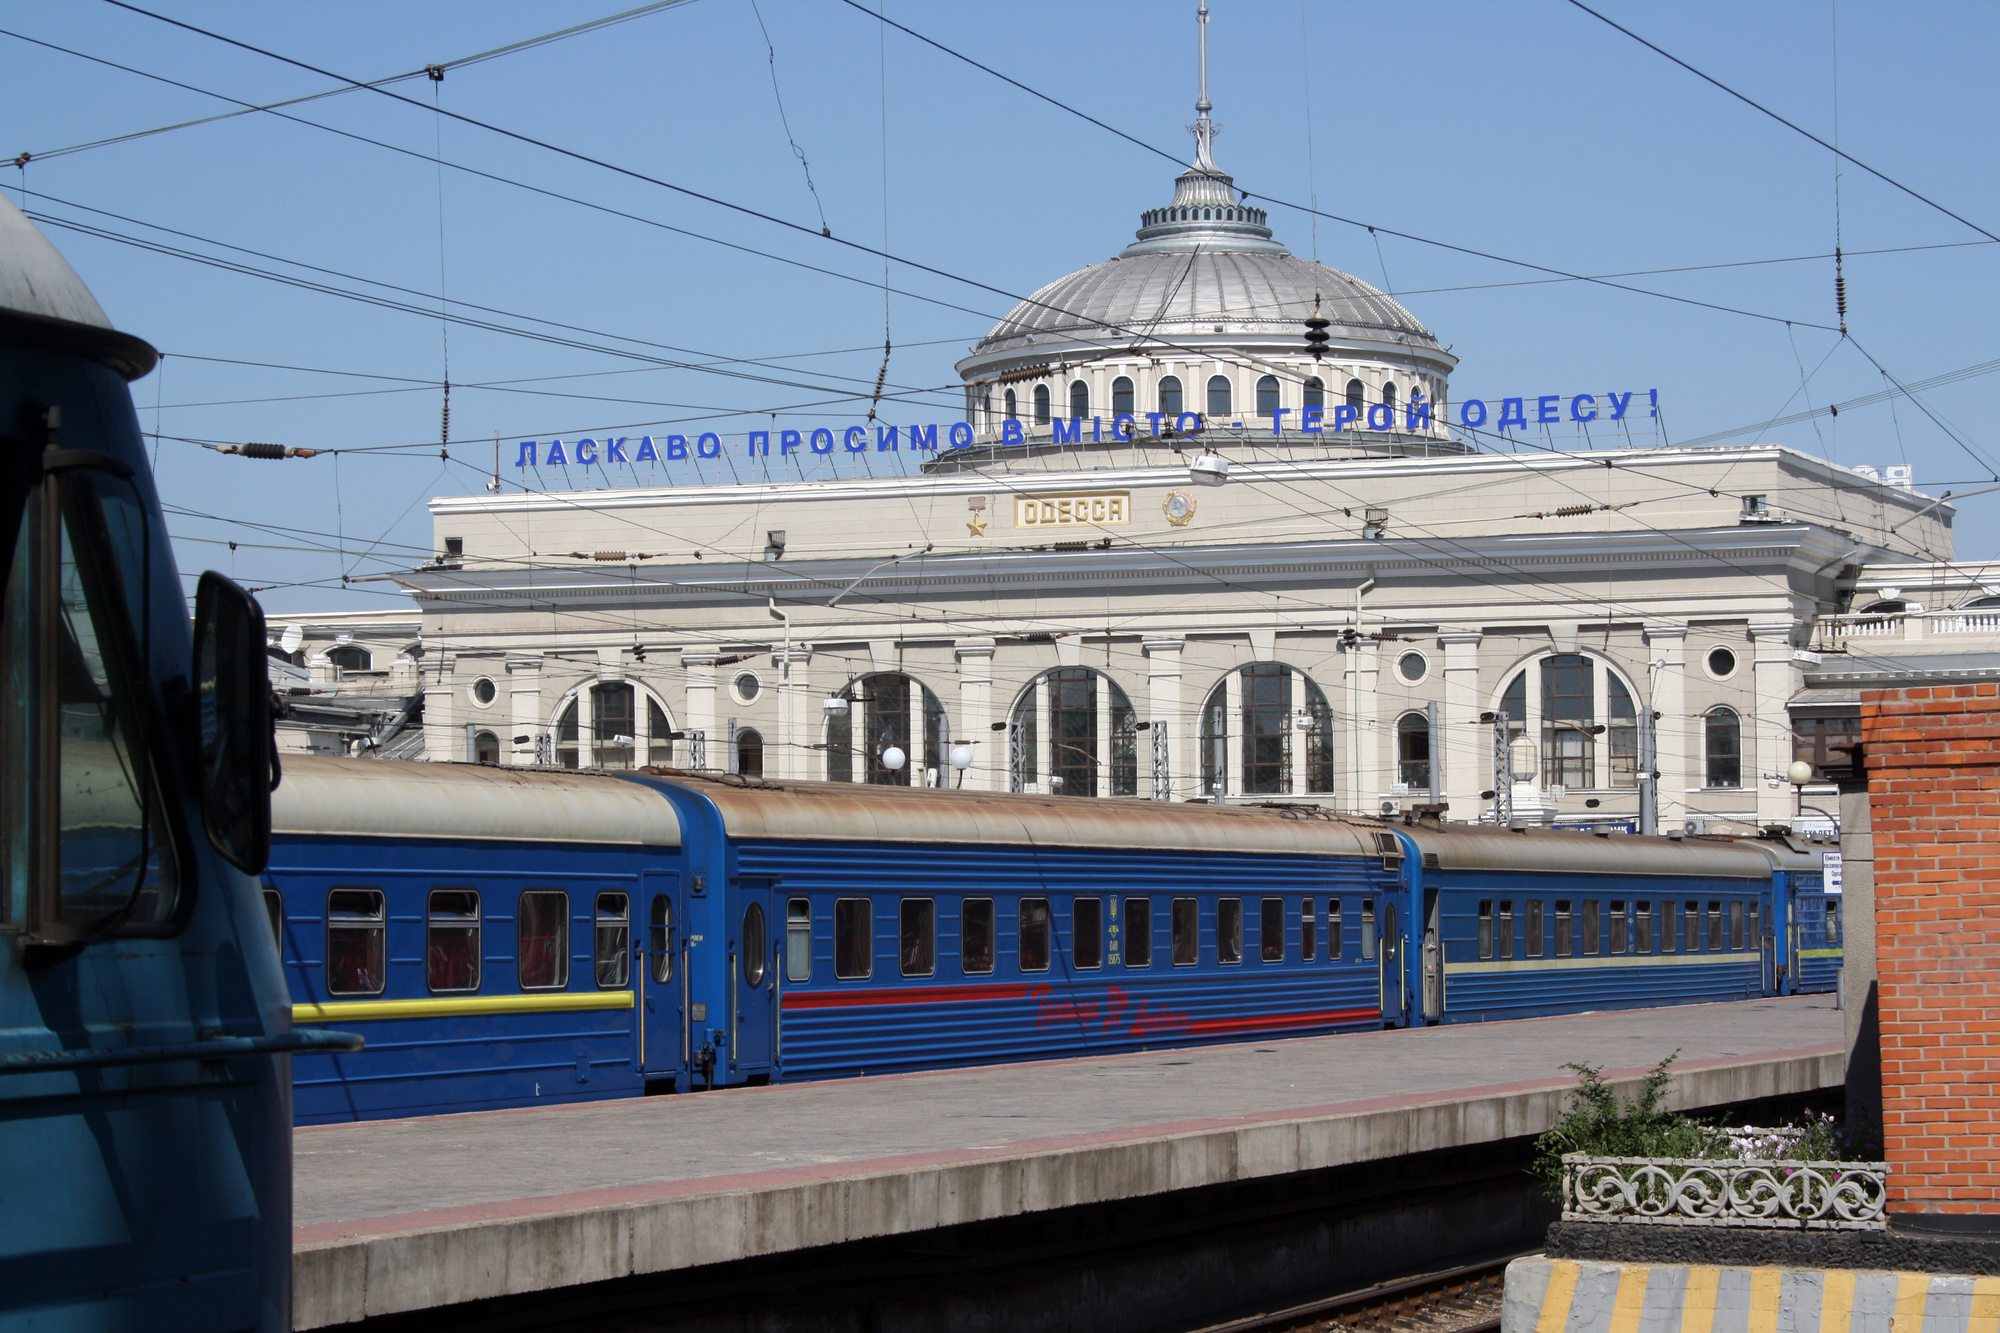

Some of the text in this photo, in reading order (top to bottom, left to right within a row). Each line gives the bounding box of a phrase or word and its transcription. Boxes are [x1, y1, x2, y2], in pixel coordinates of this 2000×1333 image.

[514, 431, 722, 470] ЛАСКАВО
[747, 418, 976, 459] ПРОСИМО
[1001, 418, 1026, 448] В
[1052, 412, 1202, 445] МІСТО
[1272, 394, 1431, 436] ГЕРОЙ
[1459, 387, 1660, 431] ОДЕСУ!
[1024, 498, 1123, 524] ОДЕССА
